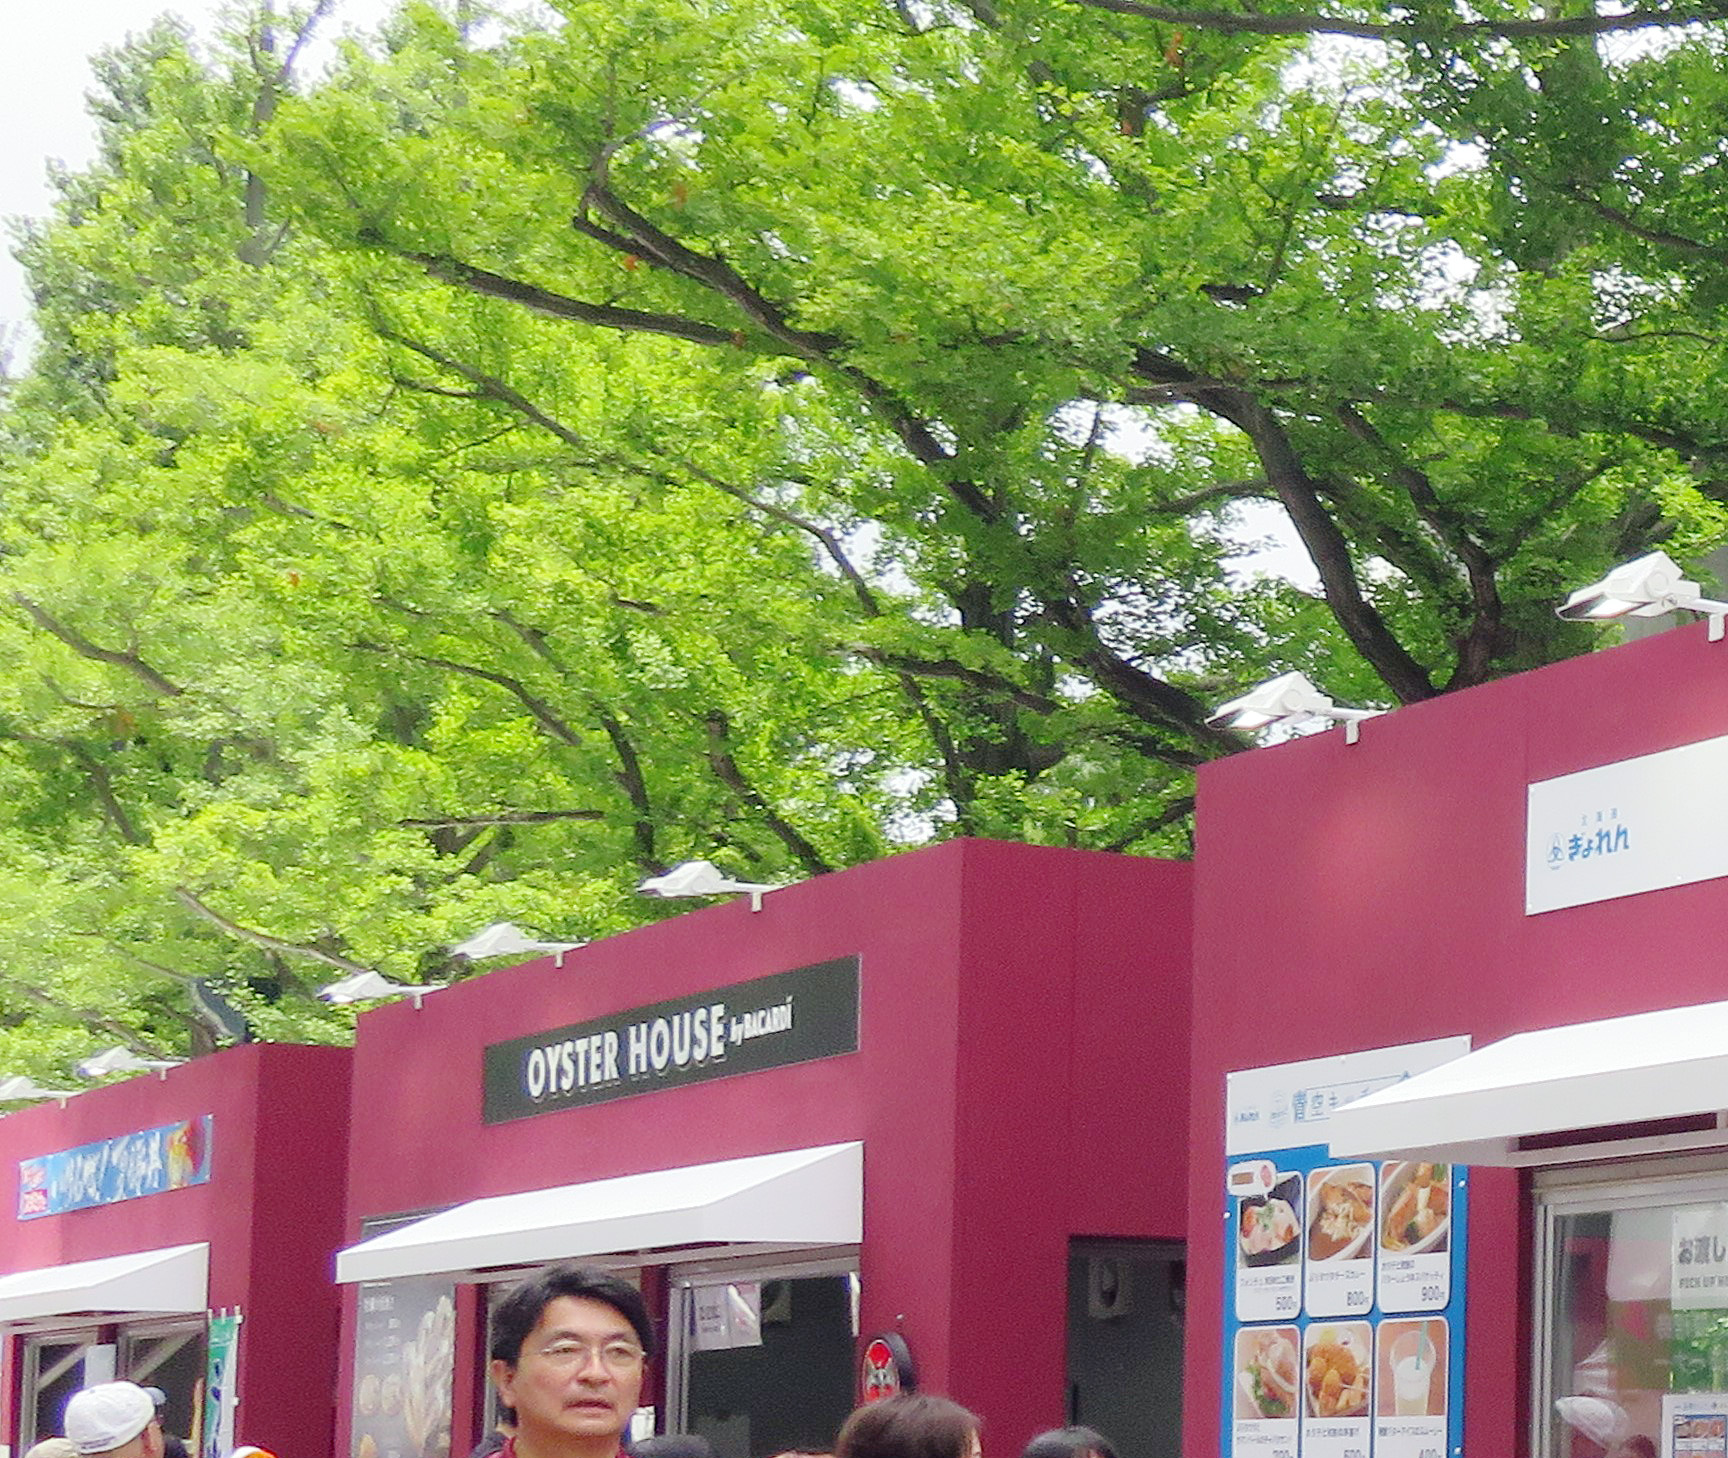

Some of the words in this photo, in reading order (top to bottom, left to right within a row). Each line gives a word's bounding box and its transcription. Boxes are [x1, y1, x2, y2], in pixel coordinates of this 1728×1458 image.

[1568, 824, 1630, 862] ぎょれん
[526, 1029, 620, 1099] OYSTER
[628, 1002, 727, 1076] HOUSE
